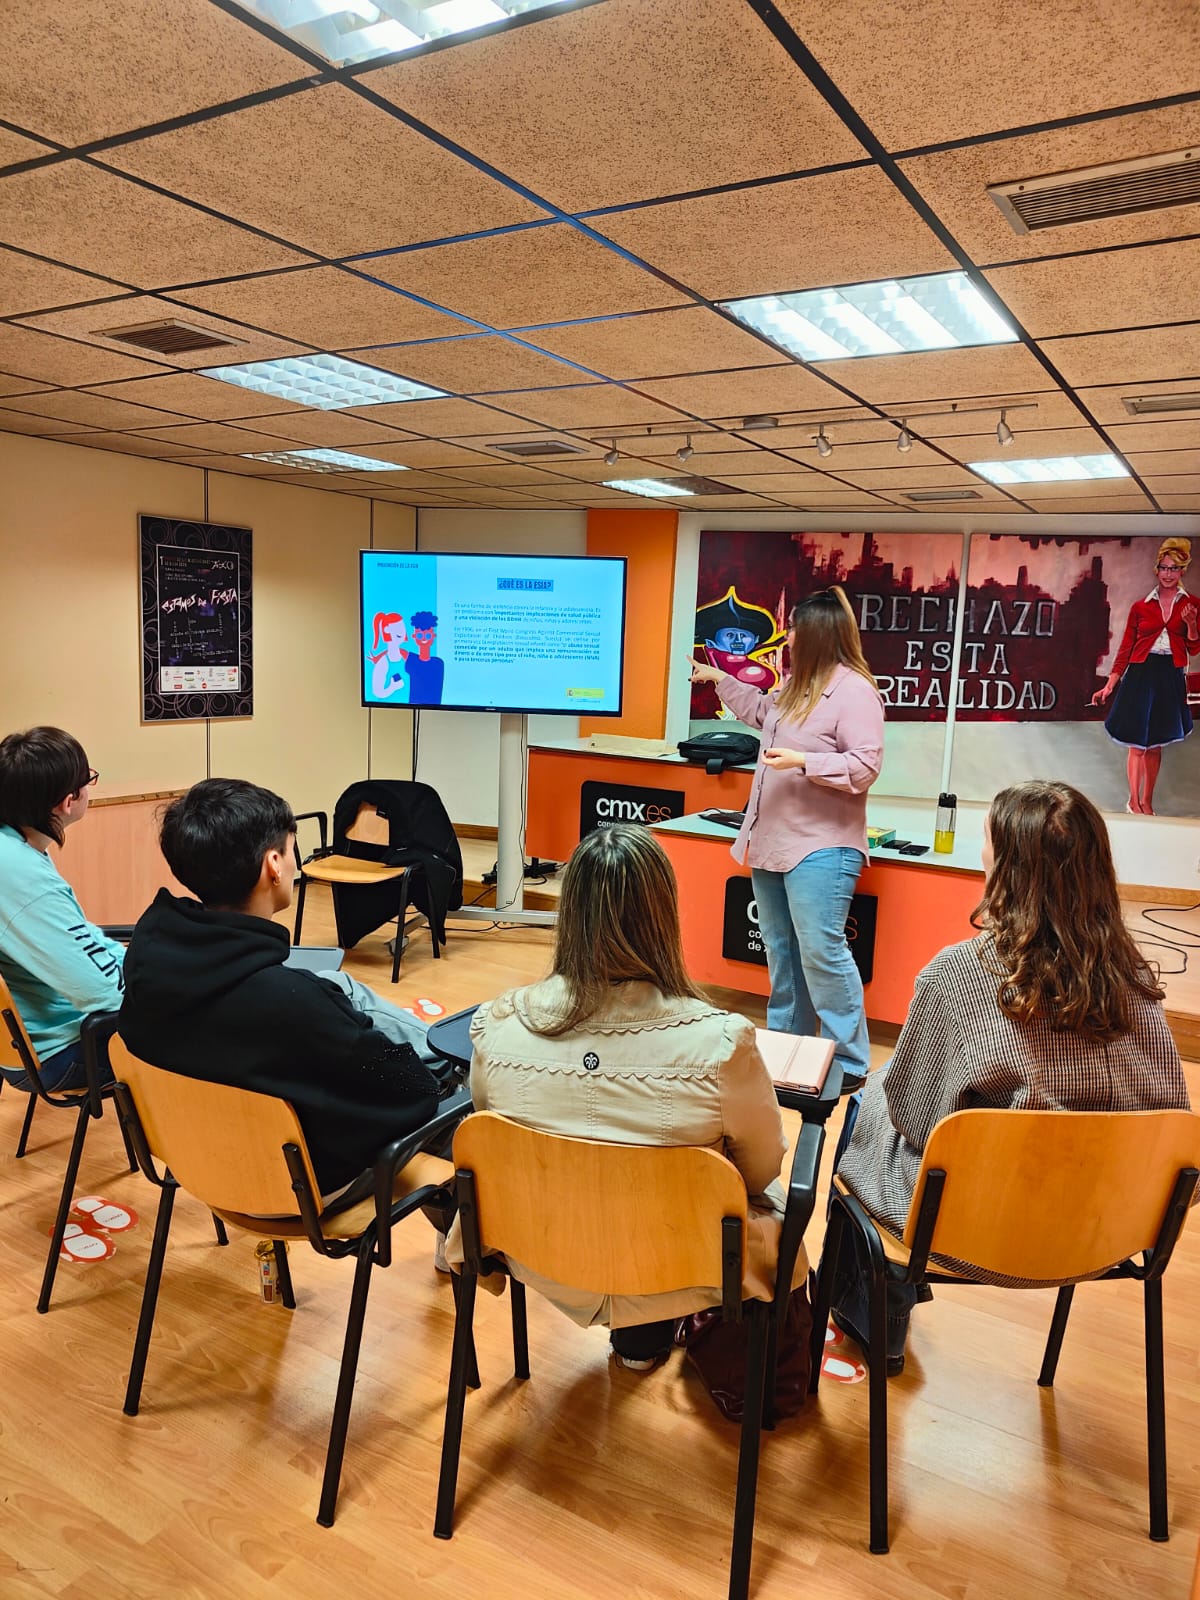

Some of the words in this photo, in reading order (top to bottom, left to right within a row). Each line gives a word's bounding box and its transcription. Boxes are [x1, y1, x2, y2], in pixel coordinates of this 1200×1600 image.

[516, 580, 524, 588] ES
[855, 594, 1056, 637] RECHAZO
[904, 640, 1010, 675] ESTA
[873, 675, 1057, 711] REALIDAD
[747, 940, 762, 952] de
